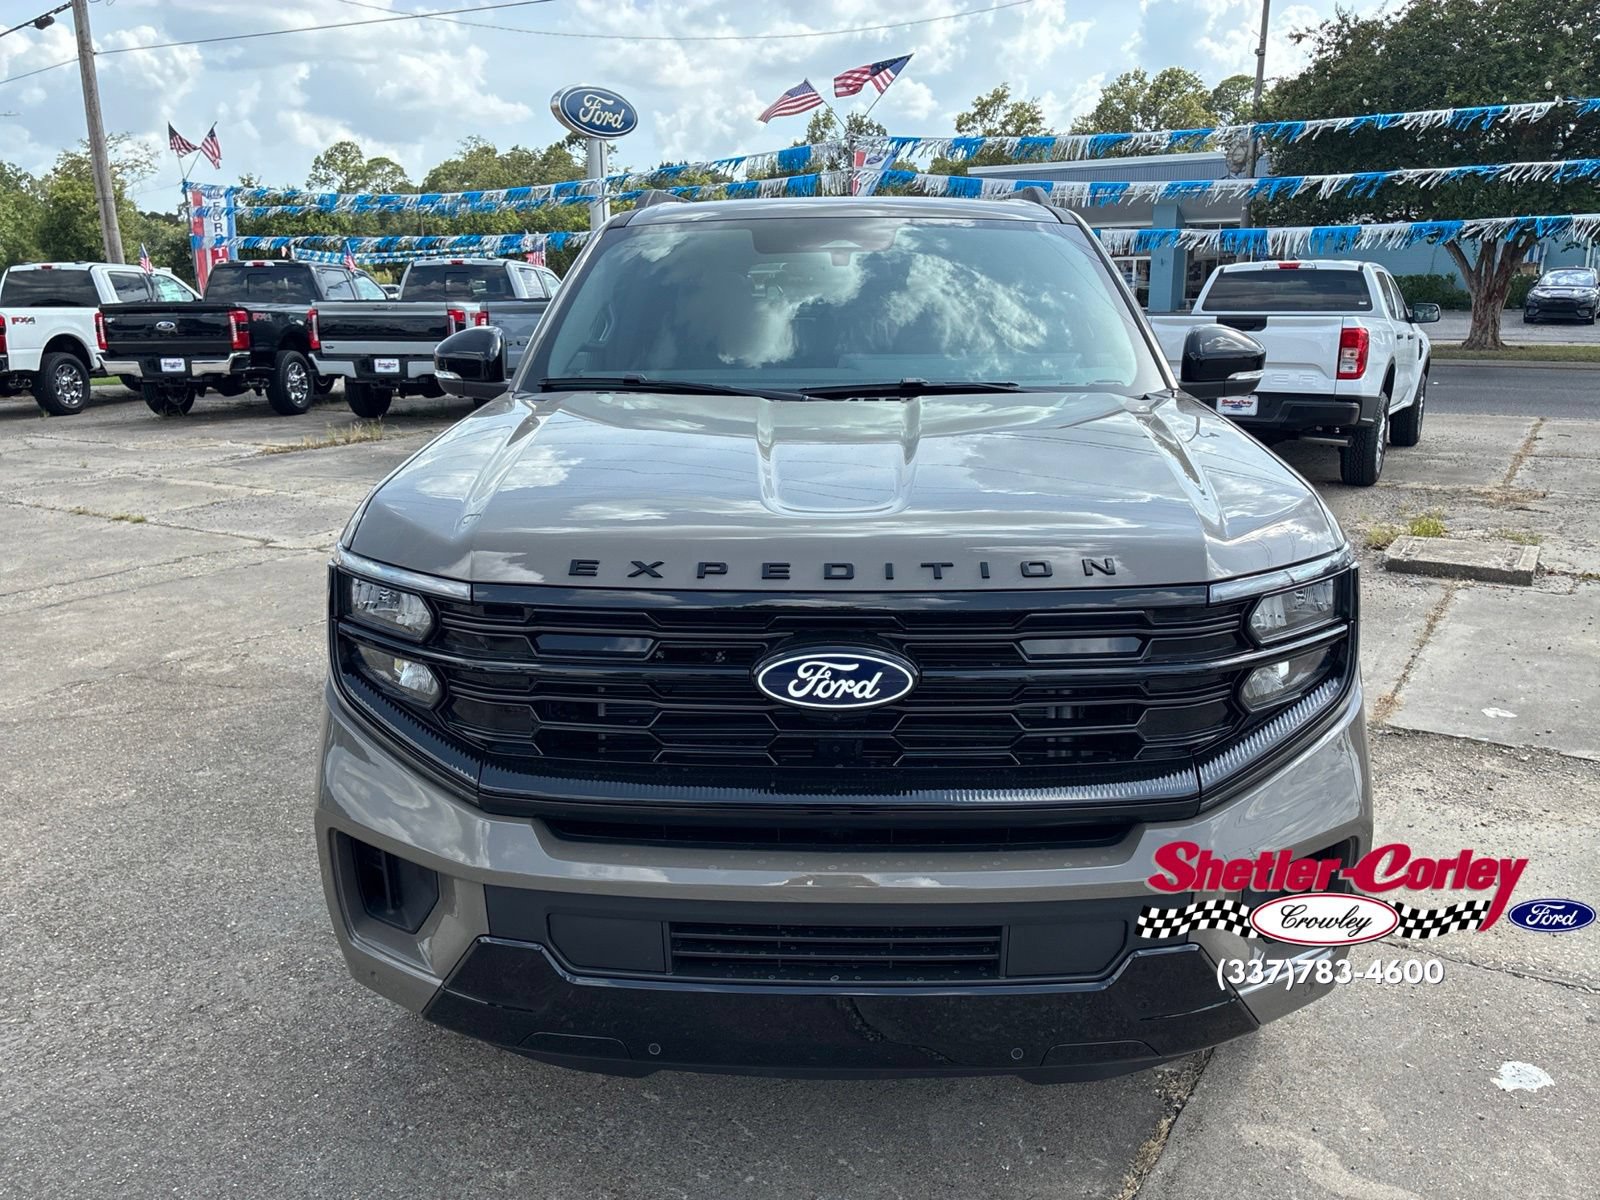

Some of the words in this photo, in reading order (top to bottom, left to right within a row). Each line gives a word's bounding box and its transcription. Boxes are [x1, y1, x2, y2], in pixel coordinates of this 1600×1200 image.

[579, 94, 625, 129] Ford
[212, 201, 224, 239] FOR
[568, 557, 1118, 581] EXPEDITION
[787, 661, 883, 698] Ford
